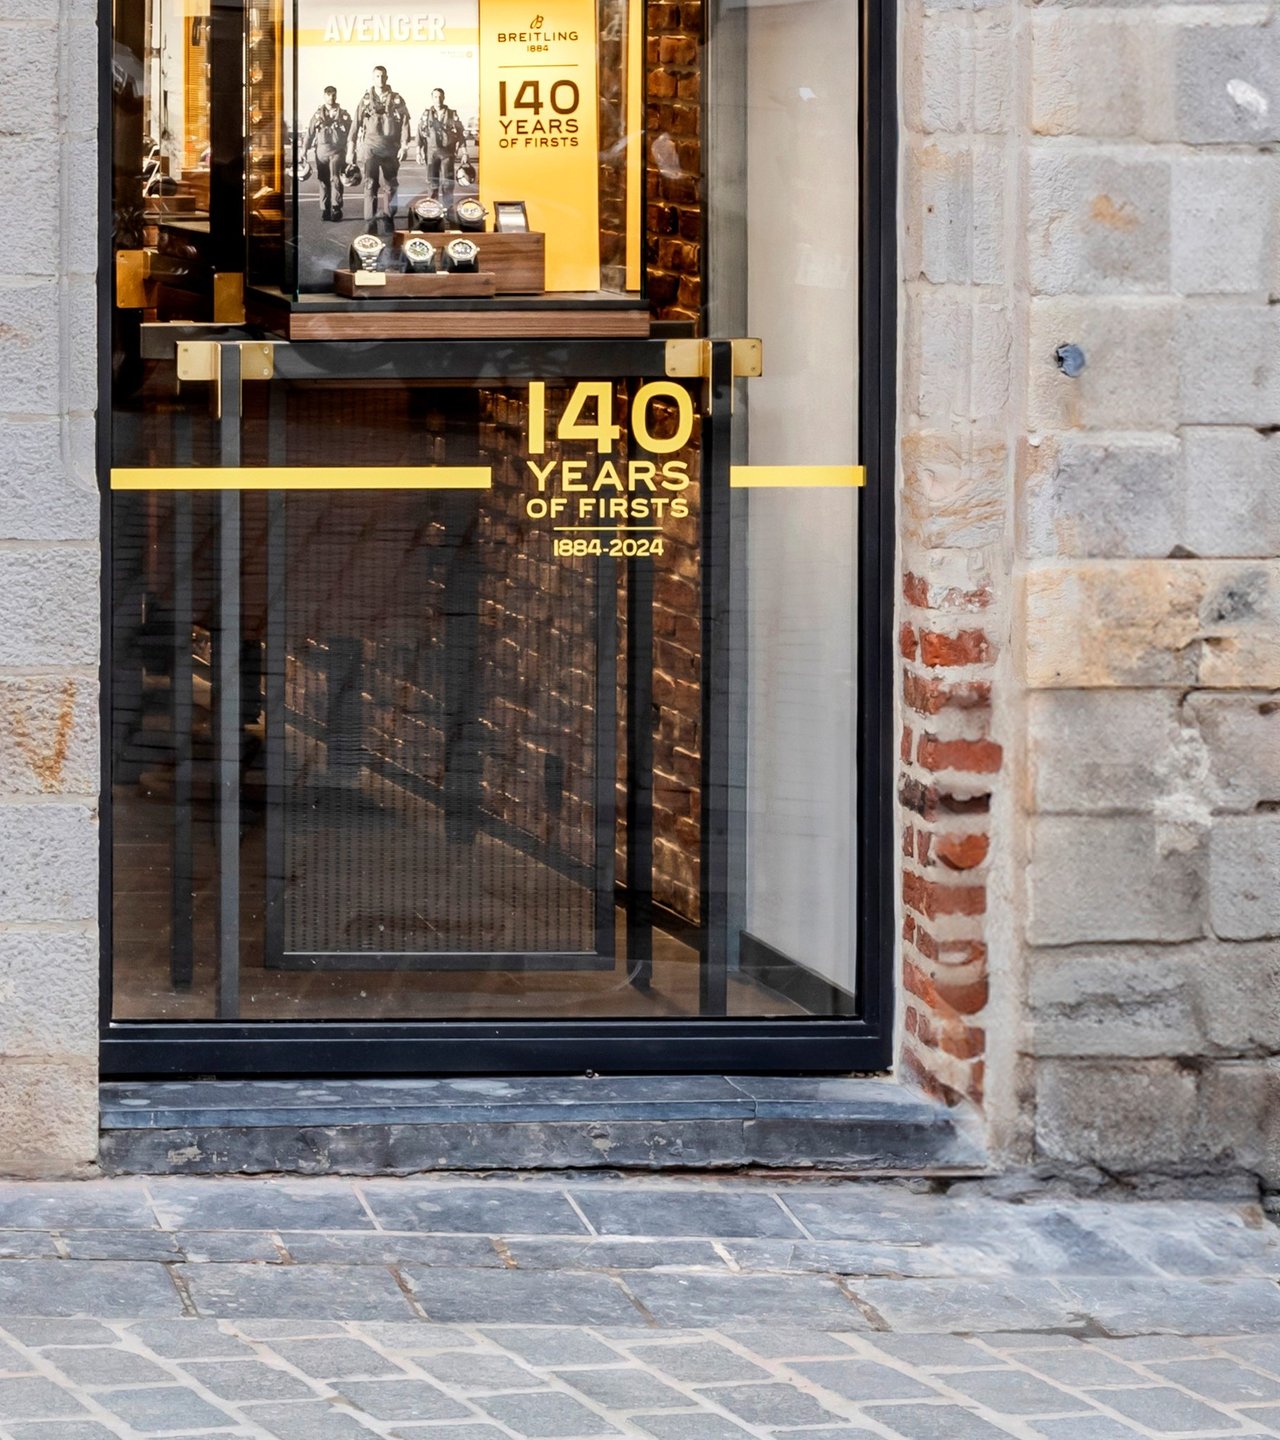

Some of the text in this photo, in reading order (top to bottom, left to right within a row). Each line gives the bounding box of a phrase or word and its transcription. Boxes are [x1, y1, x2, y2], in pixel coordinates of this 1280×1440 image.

[324, 13, 446, 43] AVENGER
[497, 31, 579, 43] BREITLING
[526, 44, 549, 52] 1884
[499, 79, 580, 117] 140
[498, 118, 579, 135] YEARS
[499, 136, 579, 148] OF FIRSTS
[527, 381, 694, 455] 140
[526, 460, 691, 492] YEARS
[526, 497, 690, 519] OF FIRSTS
[553, 538, 665, 557] 1884-2024
